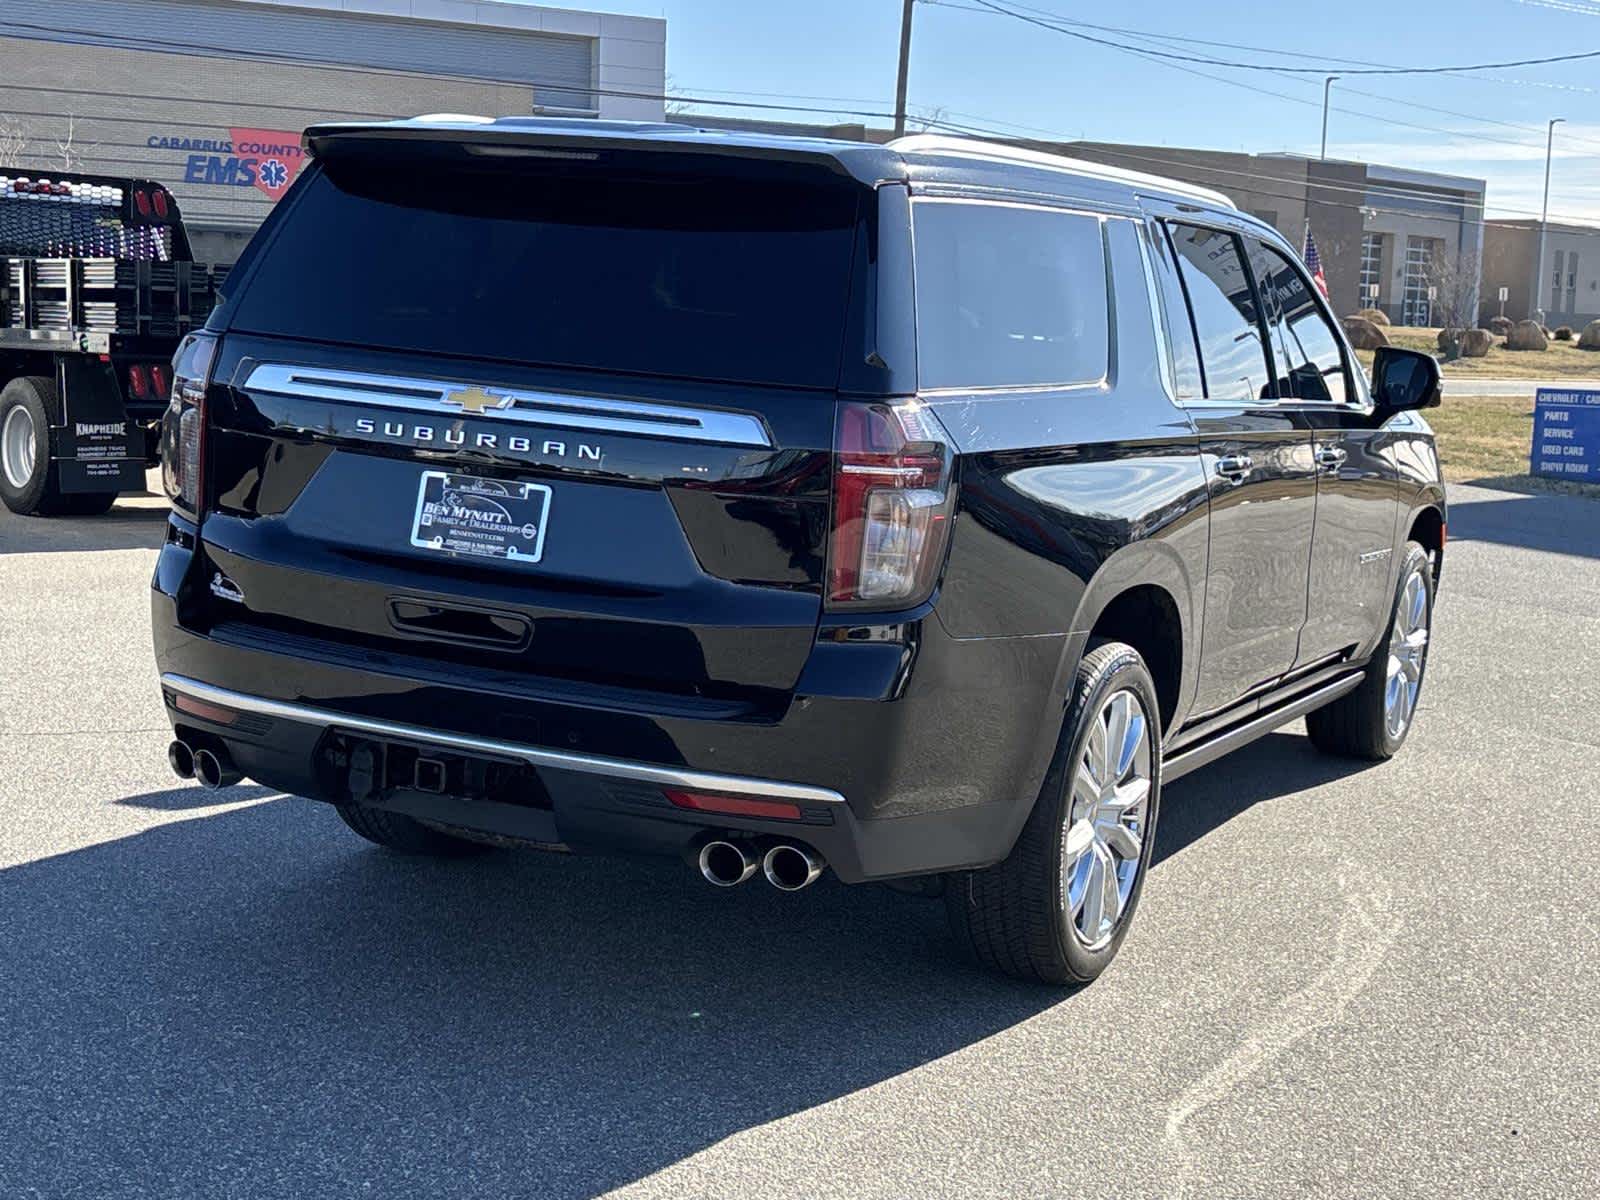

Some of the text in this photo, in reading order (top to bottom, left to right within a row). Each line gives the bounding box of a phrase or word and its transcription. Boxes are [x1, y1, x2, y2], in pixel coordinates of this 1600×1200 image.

[147, 135, 304, 157] CABARRUS COUNTY
[184, 154, 258, 187] EMS
[1544, 411, 1569, 421] PARTS
[75, 422, 127, 437] KNAPHEIDE
[356, 418, 601, 460] SUBURBAN
[1543, 428, 1574, 439] SERVICE
[1542, 444, 1584, 456] USED CARS
[424, 502, 505, 523] BEN MYNATT
[432, 515, 458, 526] FAMILY
[469, 520, 521, 535] DEALERSHIPS
